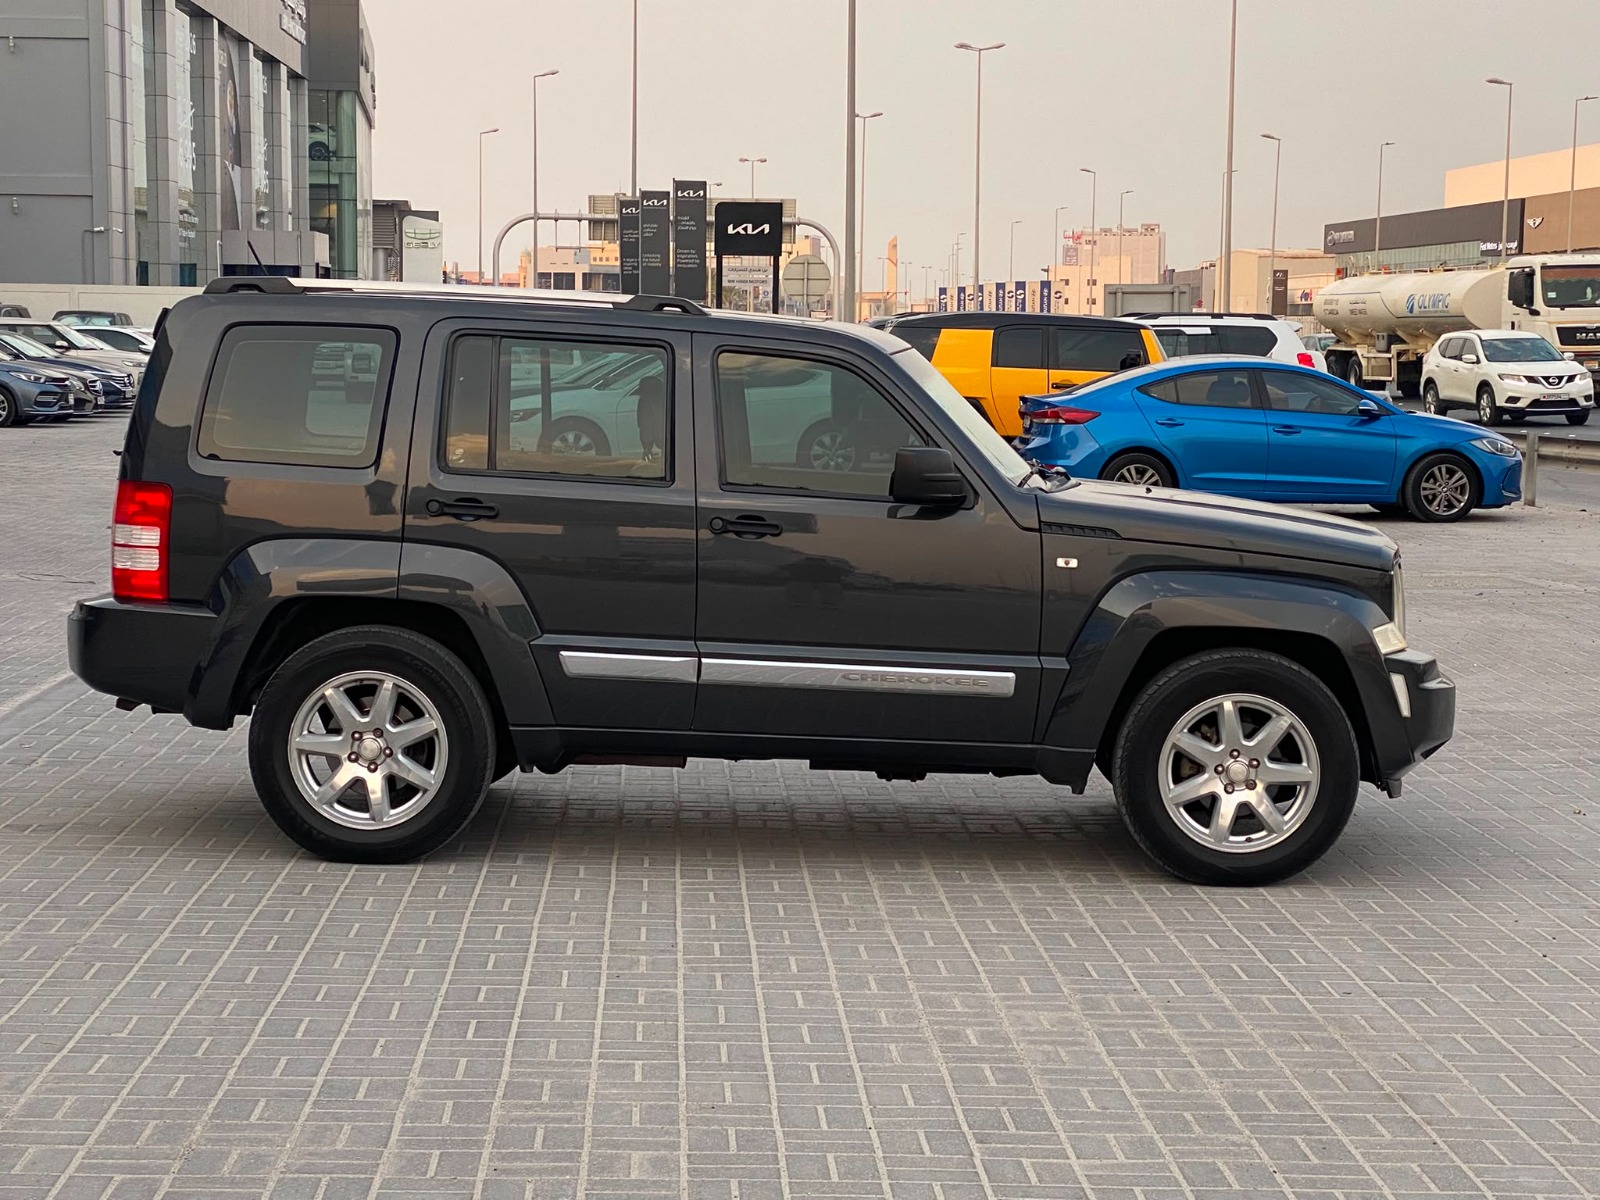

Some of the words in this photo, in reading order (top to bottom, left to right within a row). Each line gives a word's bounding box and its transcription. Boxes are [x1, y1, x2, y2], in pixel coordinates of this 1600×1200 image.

[727, 223, 769, 235] KIA
[404, 241, 441, 249] GEELY
[1418, 292, 1451, 309] OLYMPIC
[842, 673, 990, 687] CHEROKEE
